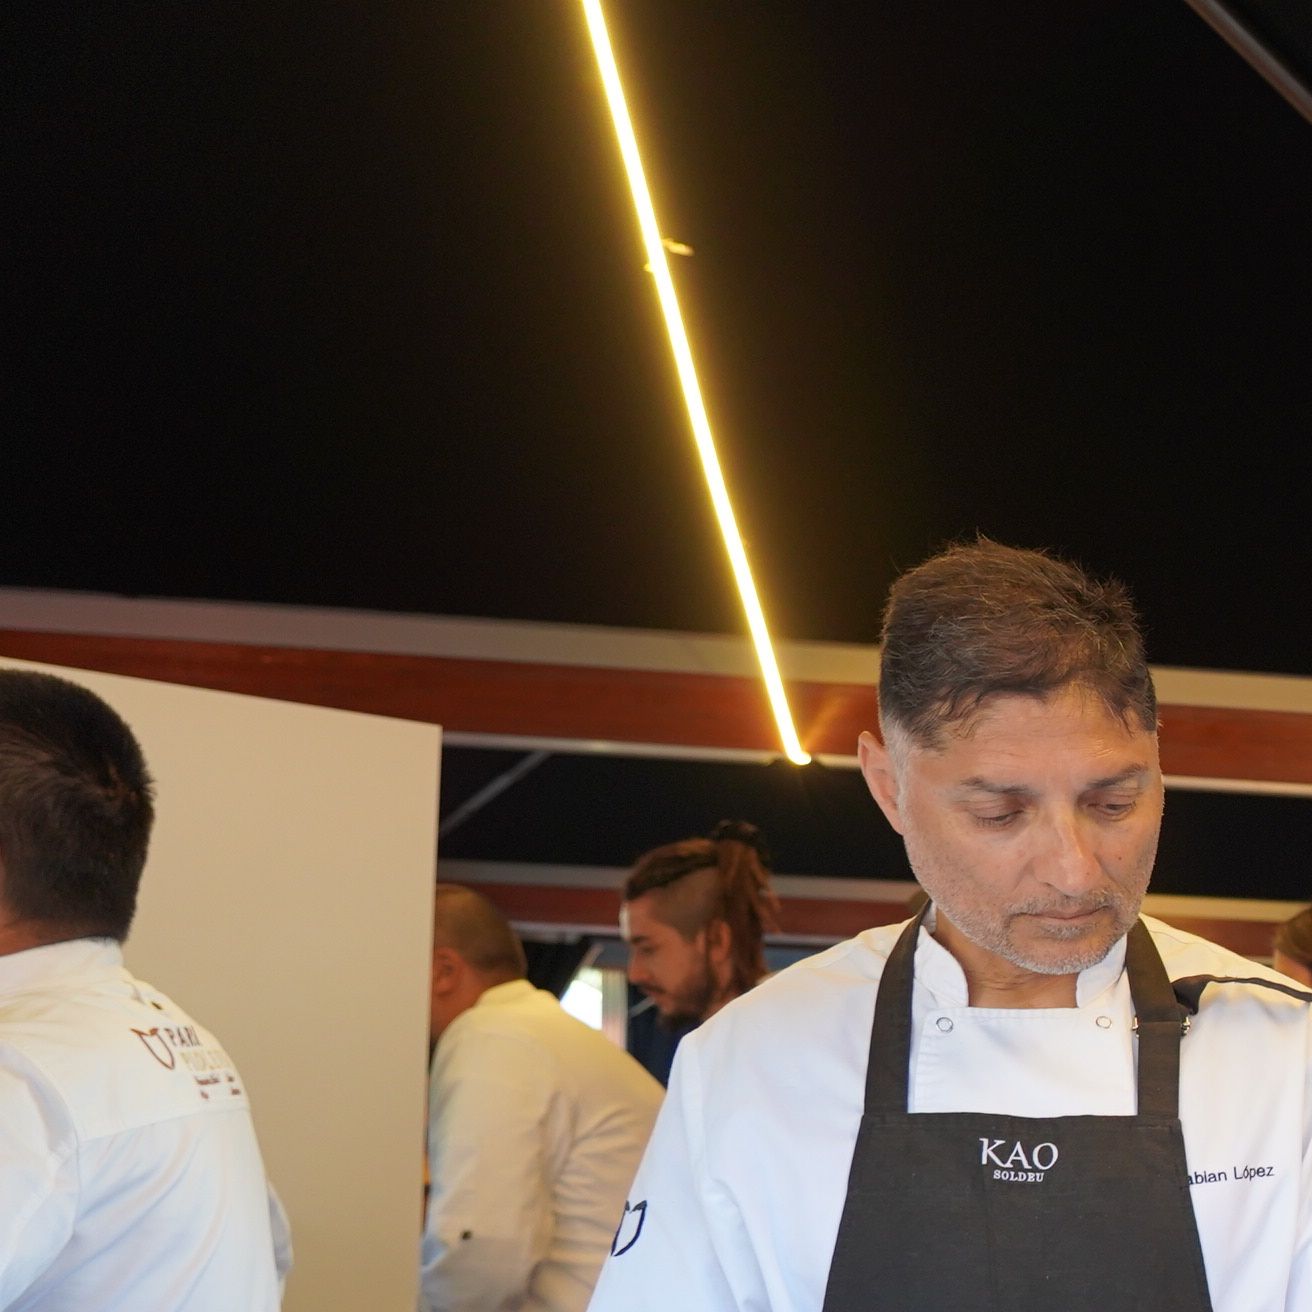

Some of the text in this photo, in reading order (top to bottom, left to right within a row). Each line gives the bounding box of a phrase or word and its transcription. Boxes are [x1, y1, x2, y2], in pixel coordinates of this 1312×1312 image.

[979, 1137, 1059, 1170] KAO
[993, 1169, 1045, 1182] SOLDEU
[1187, 1164, 1275, 1185] abian López
